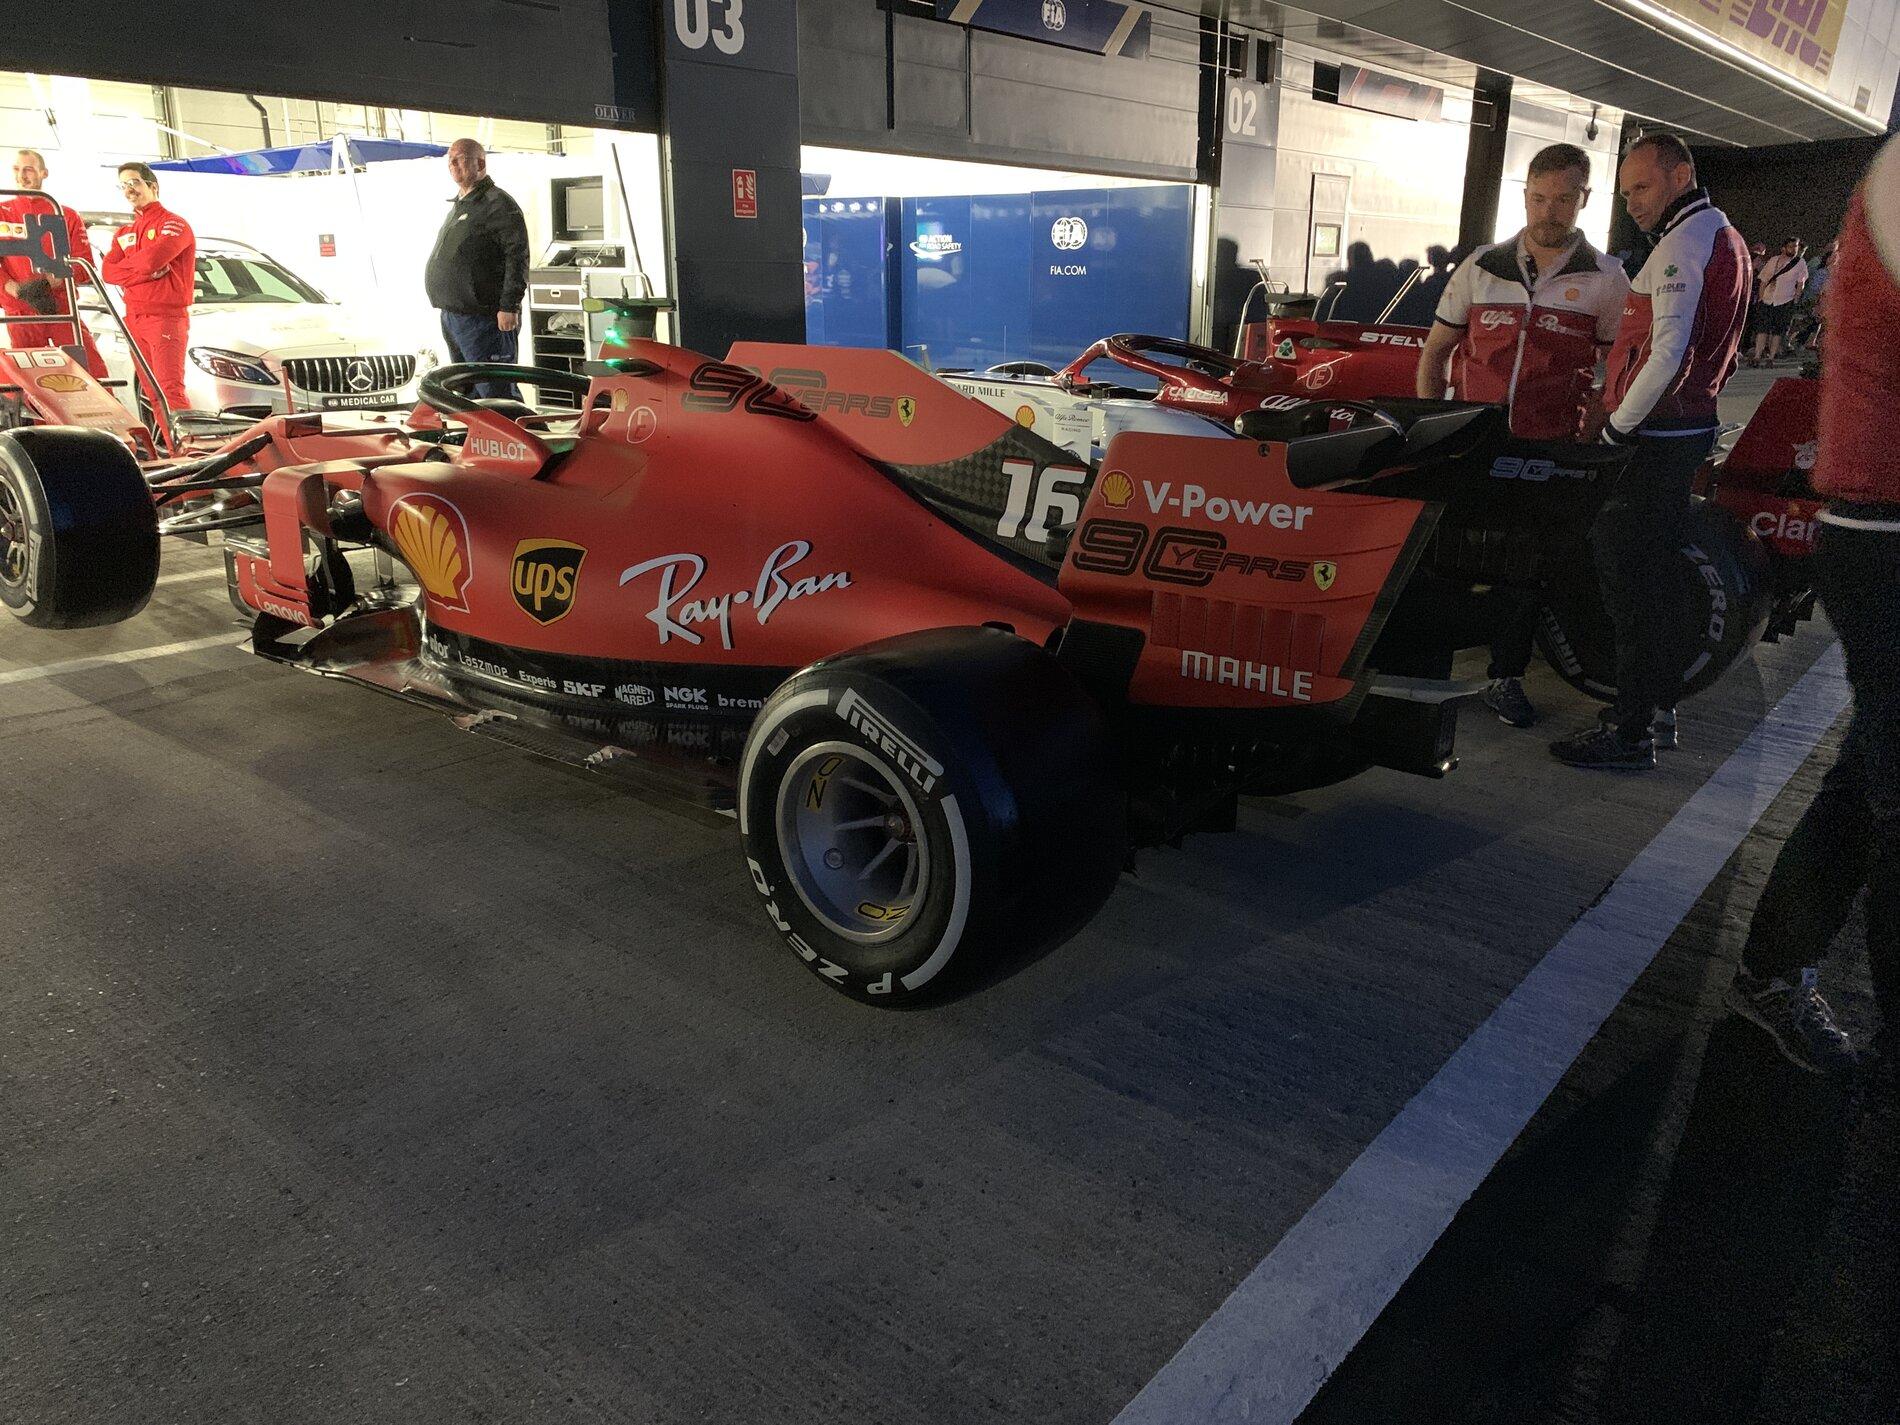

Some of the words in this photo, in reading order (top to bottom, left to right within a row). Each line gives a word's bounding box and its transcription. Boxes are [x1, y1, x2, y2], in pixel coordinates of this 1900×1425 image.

[594, 104, 635, 121] OLIVER
[1229, 87, 1257, 136] 02
[1049, 265, 1087, 276] FIA.COM
[1359, 331, 1425, 348] STELV
[4, 351, 67, 369] 16
[340, 396, 378, 407] MEDICAL
[380, 394, 396, 404] CAR
[953, 383, 975, 395] ARD
[978, 387, 1006, 398] MILLE
[1168, 386, 1229, 403] CARRERA
[470, 437, 527, 461] HUBLOT
[997, 461, 1087, 543] 16
[1142, 480, 1313, 531] V-Power
[1751, 511, 1818, 541] Clar
[1172, 545, 1307, 582] YEARS
[513, 560, 576, 612] ups
[255, 594, 309, 626] Lenovo
[518, 670, 557, 690] Experis
[563, 680, 606, 698] SKF
[1181, 650, 1314, 701] MAHLE
[664, 687, 708, 703] NGK
[717, 693, 765, 709] brem
[835, 687, 945, 794] PIRELLI
[747, 856, 850, 985] ZERO
[866, 972, 892, 995] P
